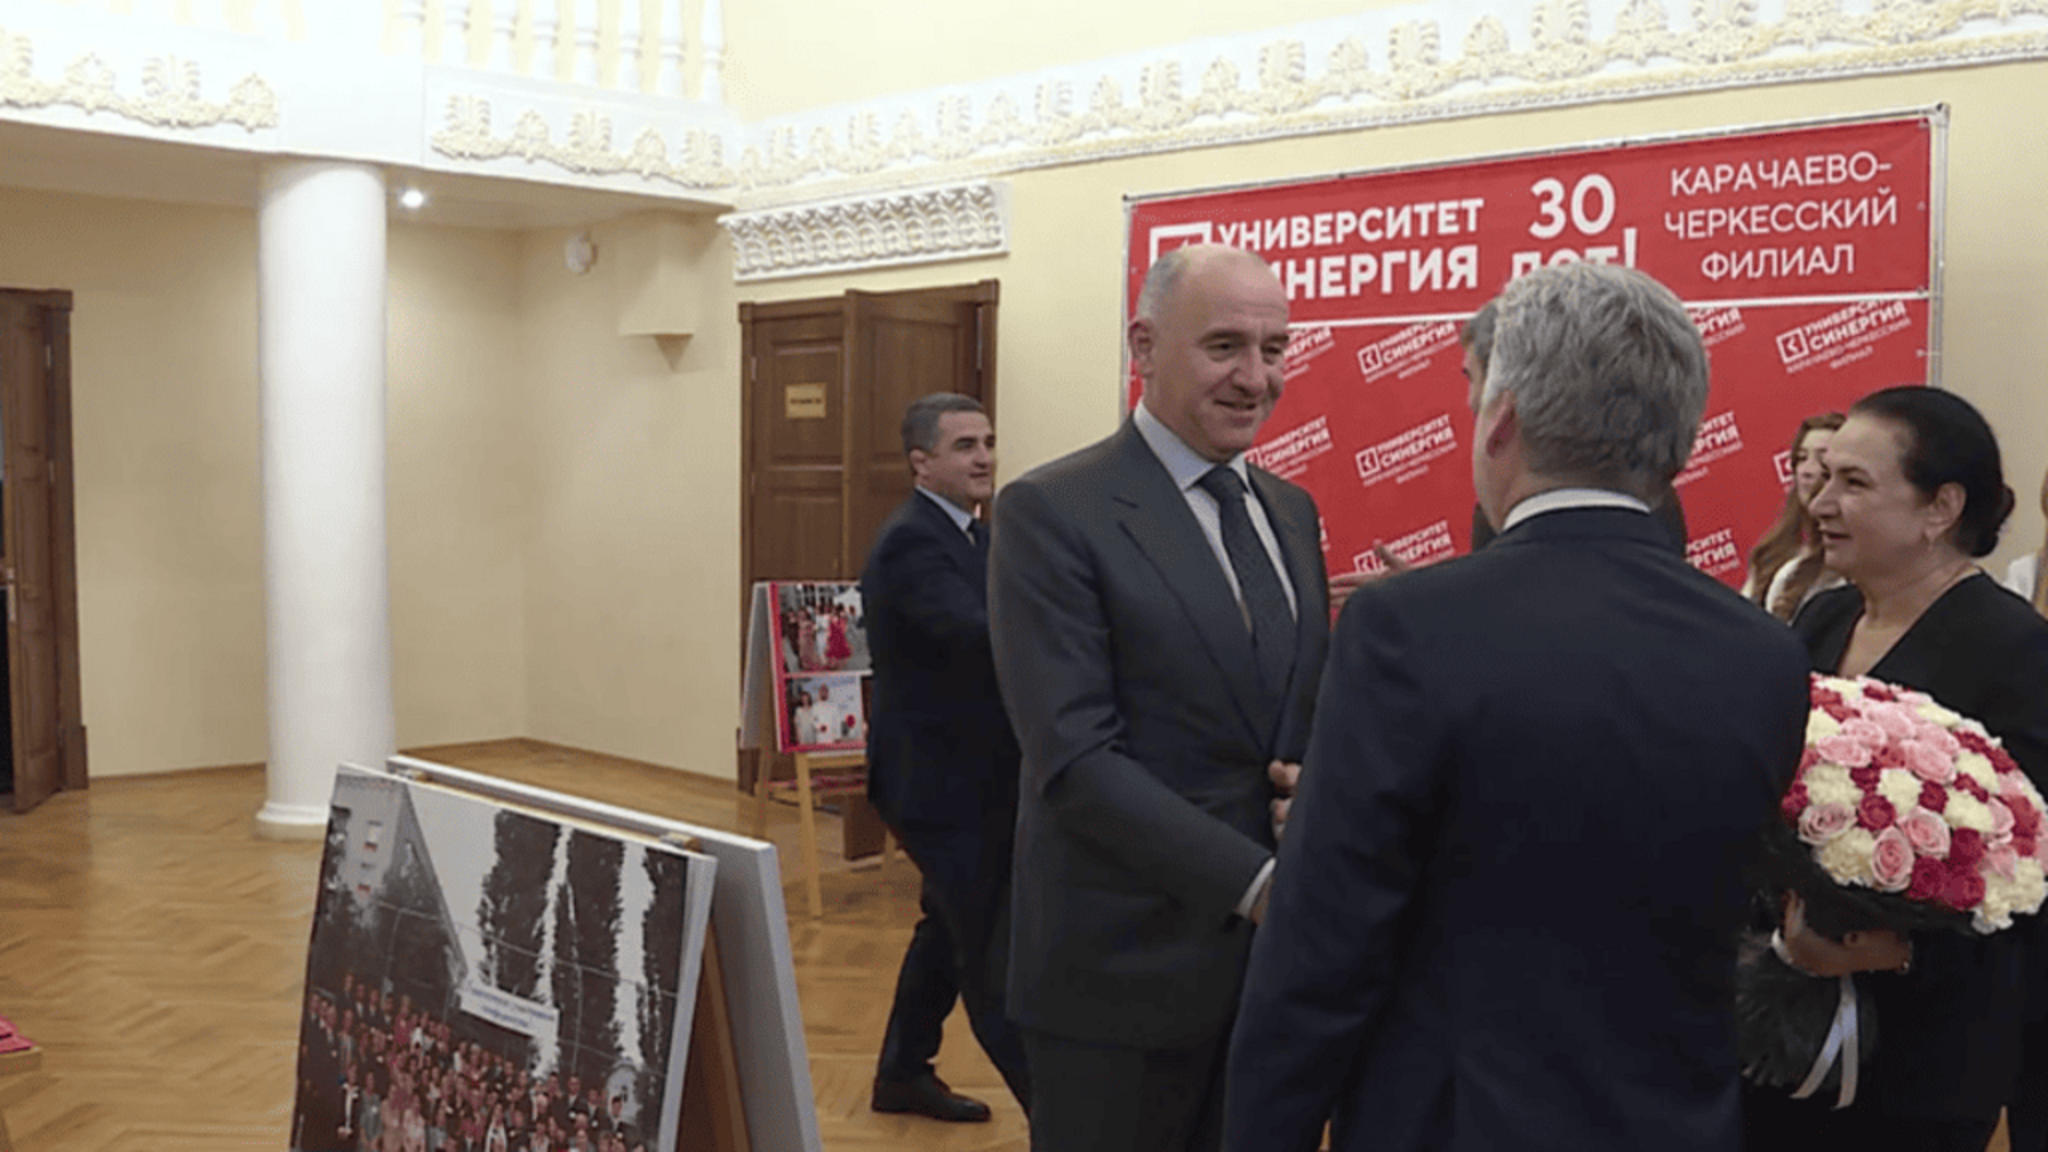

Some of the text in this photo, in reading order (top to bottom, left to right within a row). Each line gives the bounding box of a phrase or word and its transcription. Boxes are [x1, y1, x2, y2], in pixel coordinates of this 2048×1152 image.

[1671, 151, 1892, 196] КАРАЧАЕВО-
[1218, 198, 1484, 251] УНИВЕРСИТЕТ
[1530, 174, 1615, 239] 30
[1665, 187, 1898, 240] ЧЕРКЕССКИЙ
[1270, 245, 1478, 300] НЕРГИЯ
[1701, 244, 1855, 281] ФИЛИАЛ
[1809, 300, 1907, 351] СИНЕРГИЯ
[1381, 426, 1454, 467] СИНЕРГИЯ
